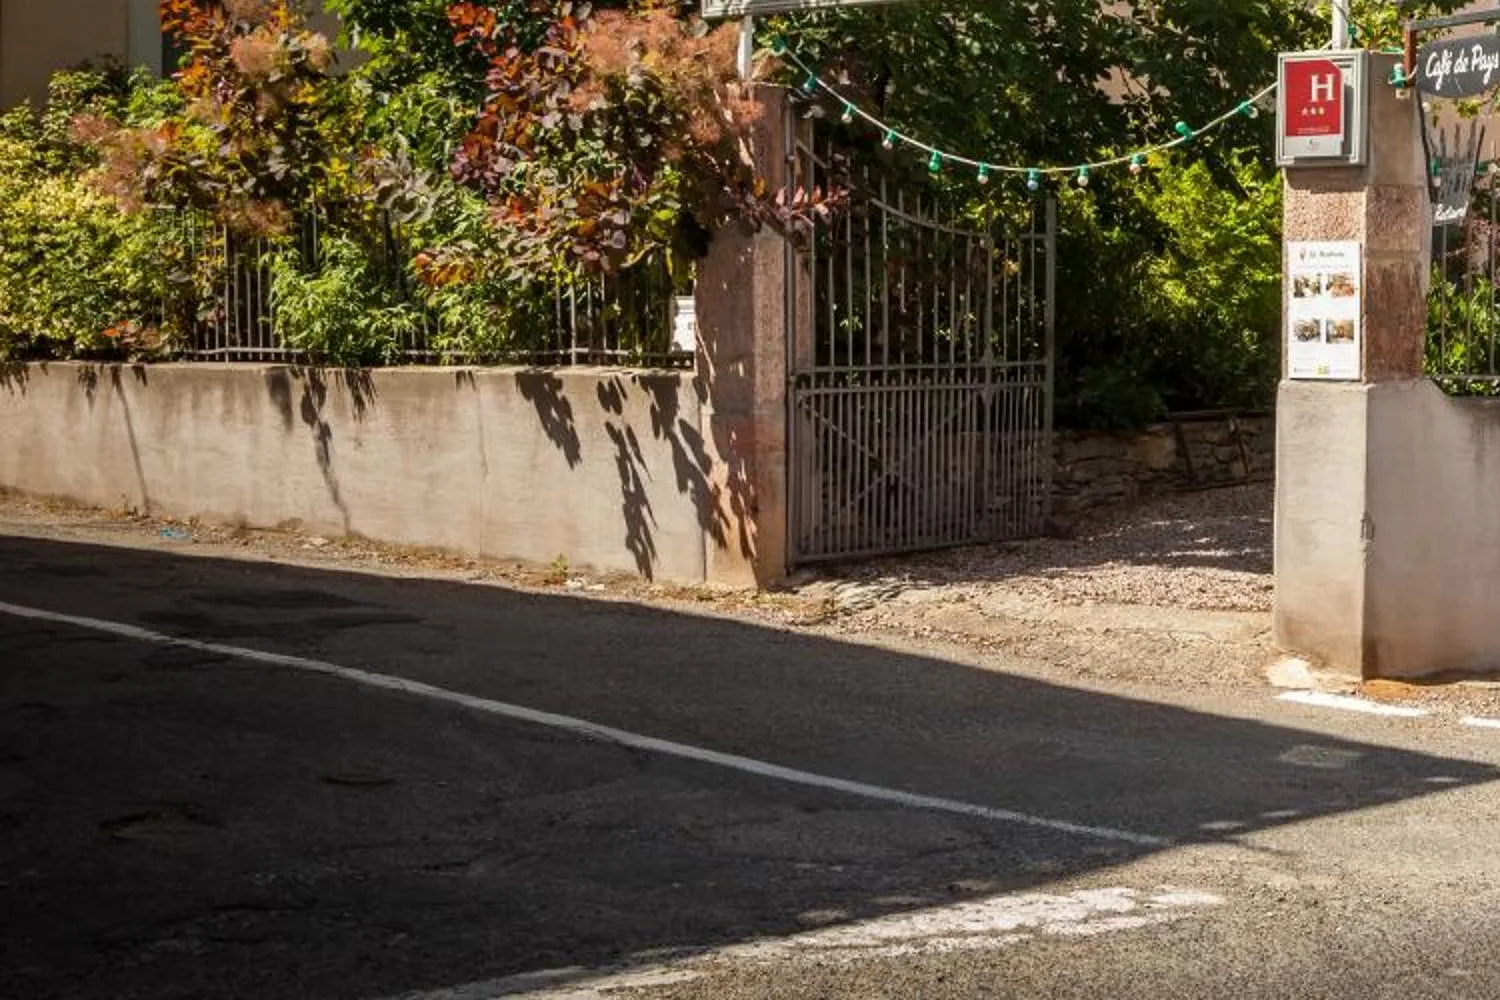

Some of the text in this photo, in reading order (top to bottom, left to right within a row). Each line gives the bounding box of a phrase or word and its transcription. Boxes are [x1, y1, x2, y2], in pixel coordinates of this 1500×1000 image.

[1425, 43, 1499, 91] Café de Pays
[1310, 72, 1336, 102] H
